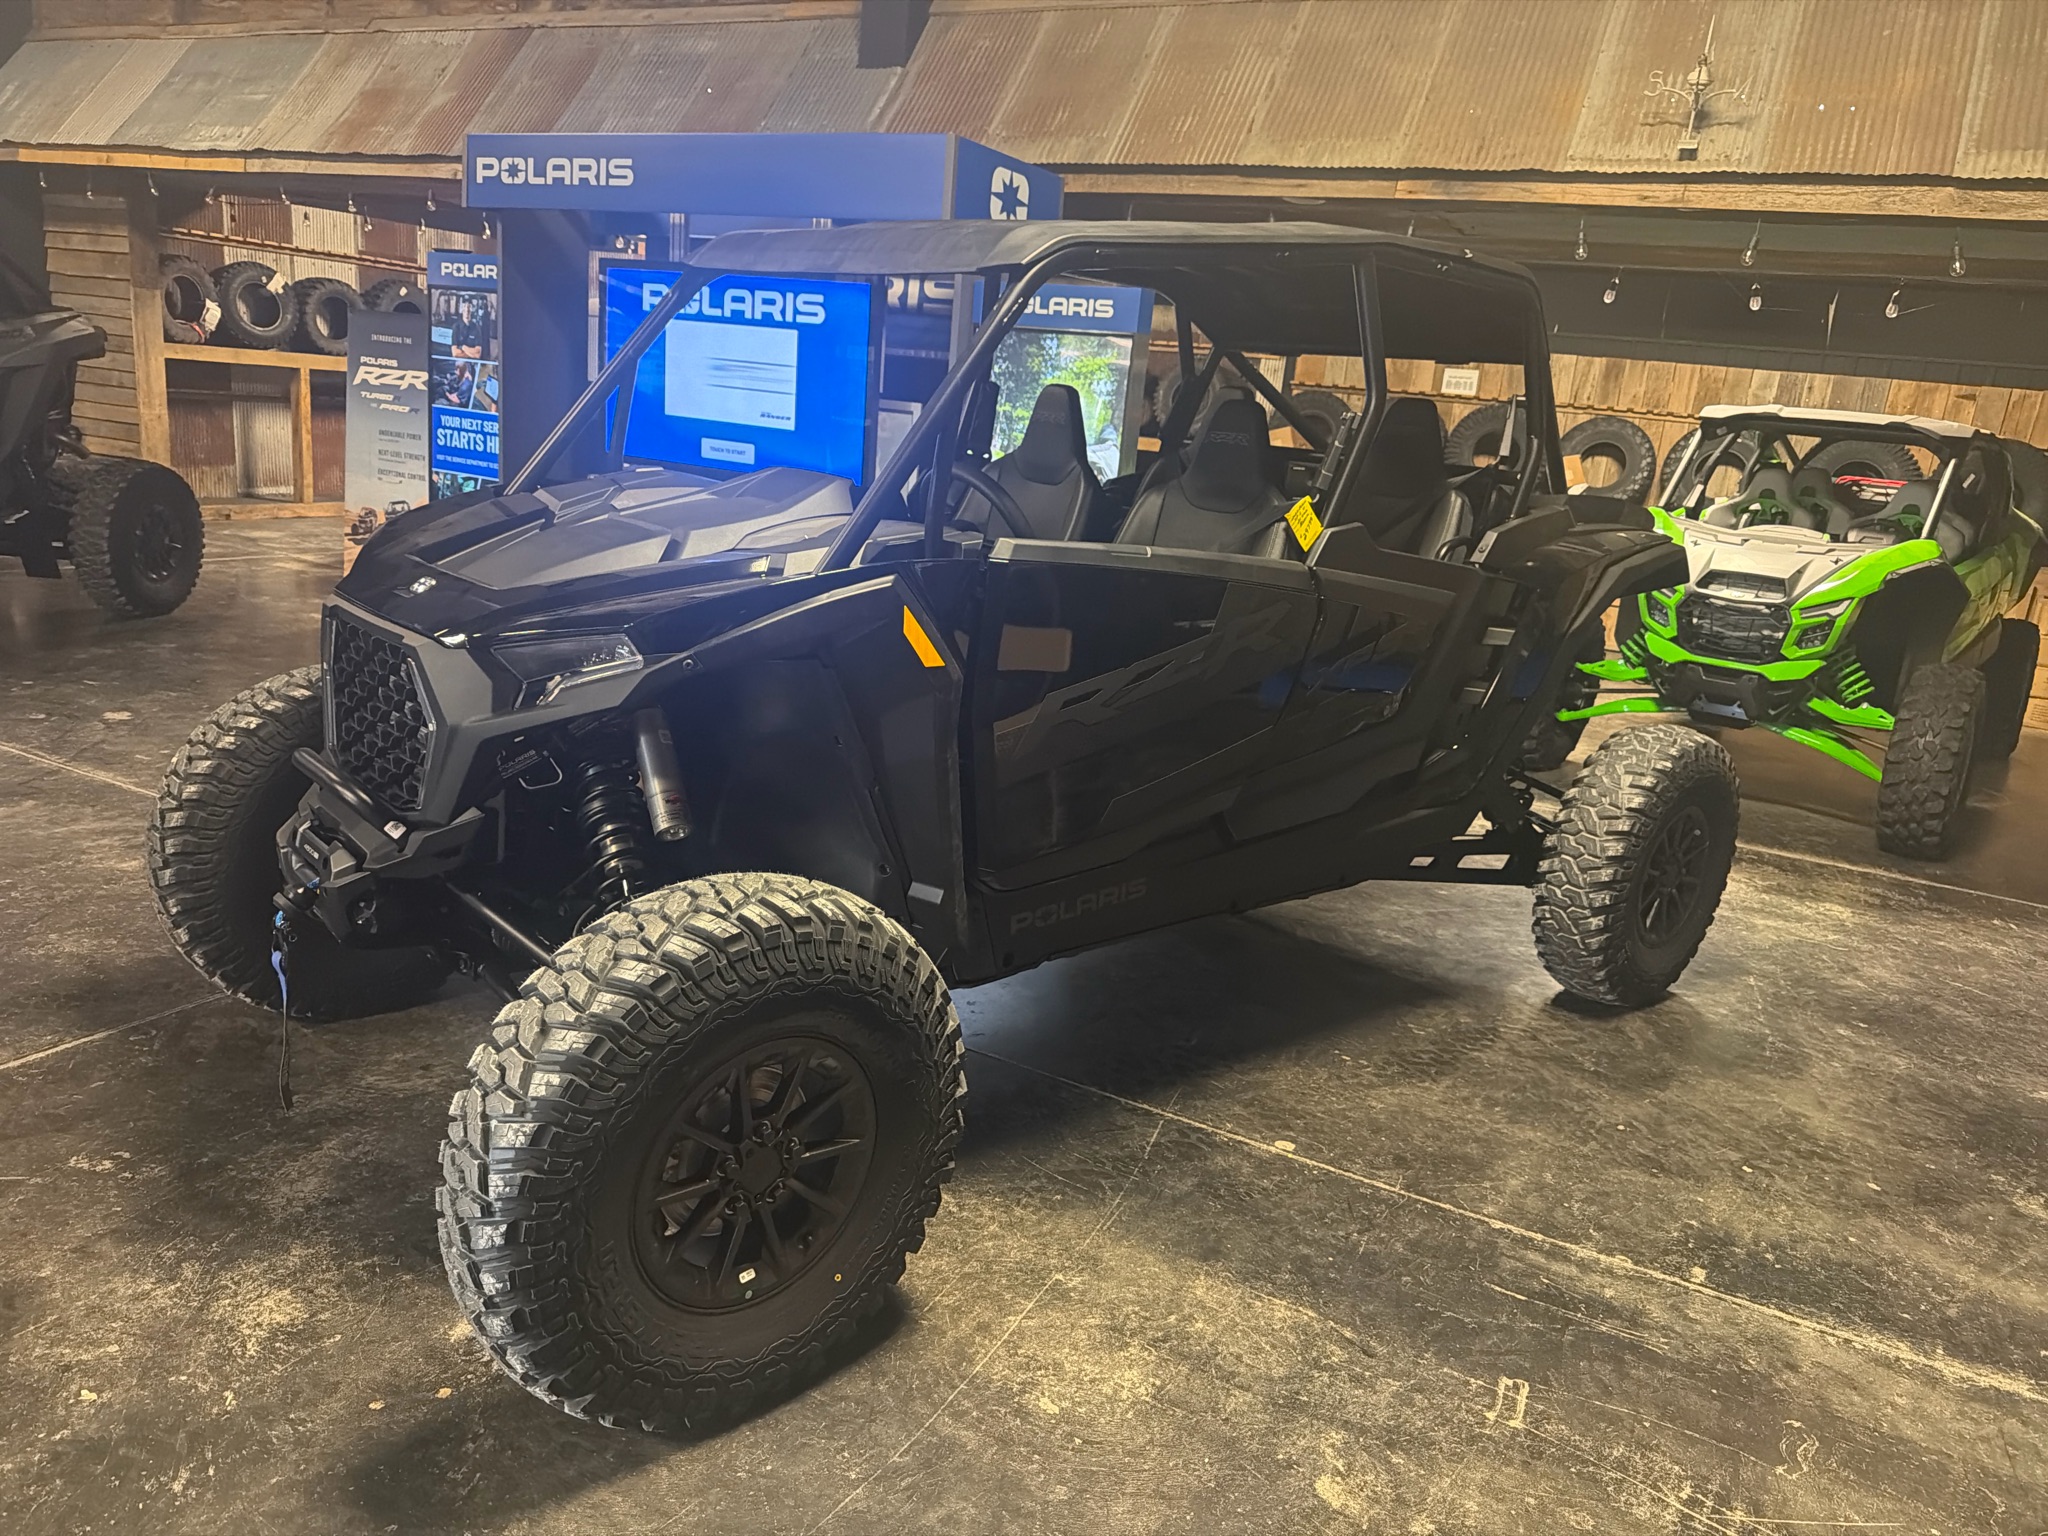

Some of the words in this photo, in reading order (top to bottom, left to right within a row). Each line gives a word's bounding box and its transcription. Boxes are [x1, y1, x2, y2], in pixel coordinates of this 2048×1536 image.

[475, 156, 635, 187] POLARIS
[441, 261, 498, 280] POLAR
[1024, 295, 1114, 319] LARIS
[360, 355, 399, 368] POLARIS
[352, 365, 429, 391] RZR
[440, 414, 461, 429] YOUR
[461, 417, 482, 432] NEXT
[483, 420, 499, 435] SER
[436, 427, 485, 452] STARTS
[1010, 876, 1148, 936] POLARIS
